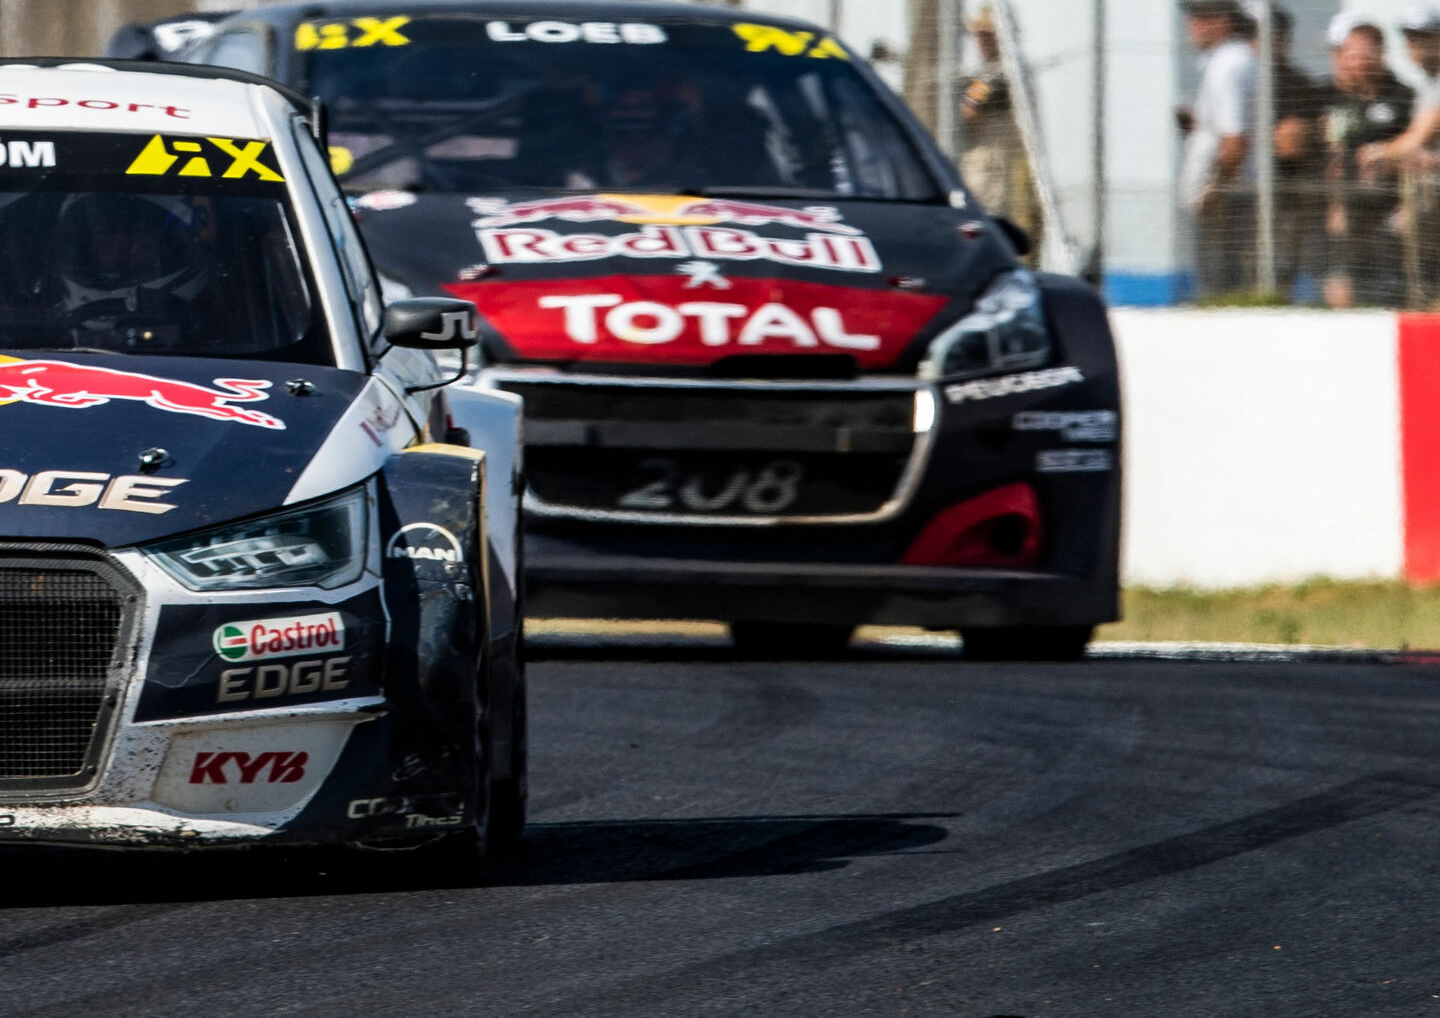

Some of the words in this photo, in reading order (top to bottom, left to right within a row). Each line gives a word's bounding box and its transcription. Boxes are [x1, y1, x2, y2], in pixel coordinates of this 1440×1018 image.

[486, 20, 667, 45] LOEB
[480, 226, 689, 263] Red
[690, 227, 881, 272] Bull
[538, 293, 882, 350] TOTAL
[249, 616, 341, 656] Castrol
[216, 655, 351, 704] EDGE
[188, 750, 310, 784] KYB
